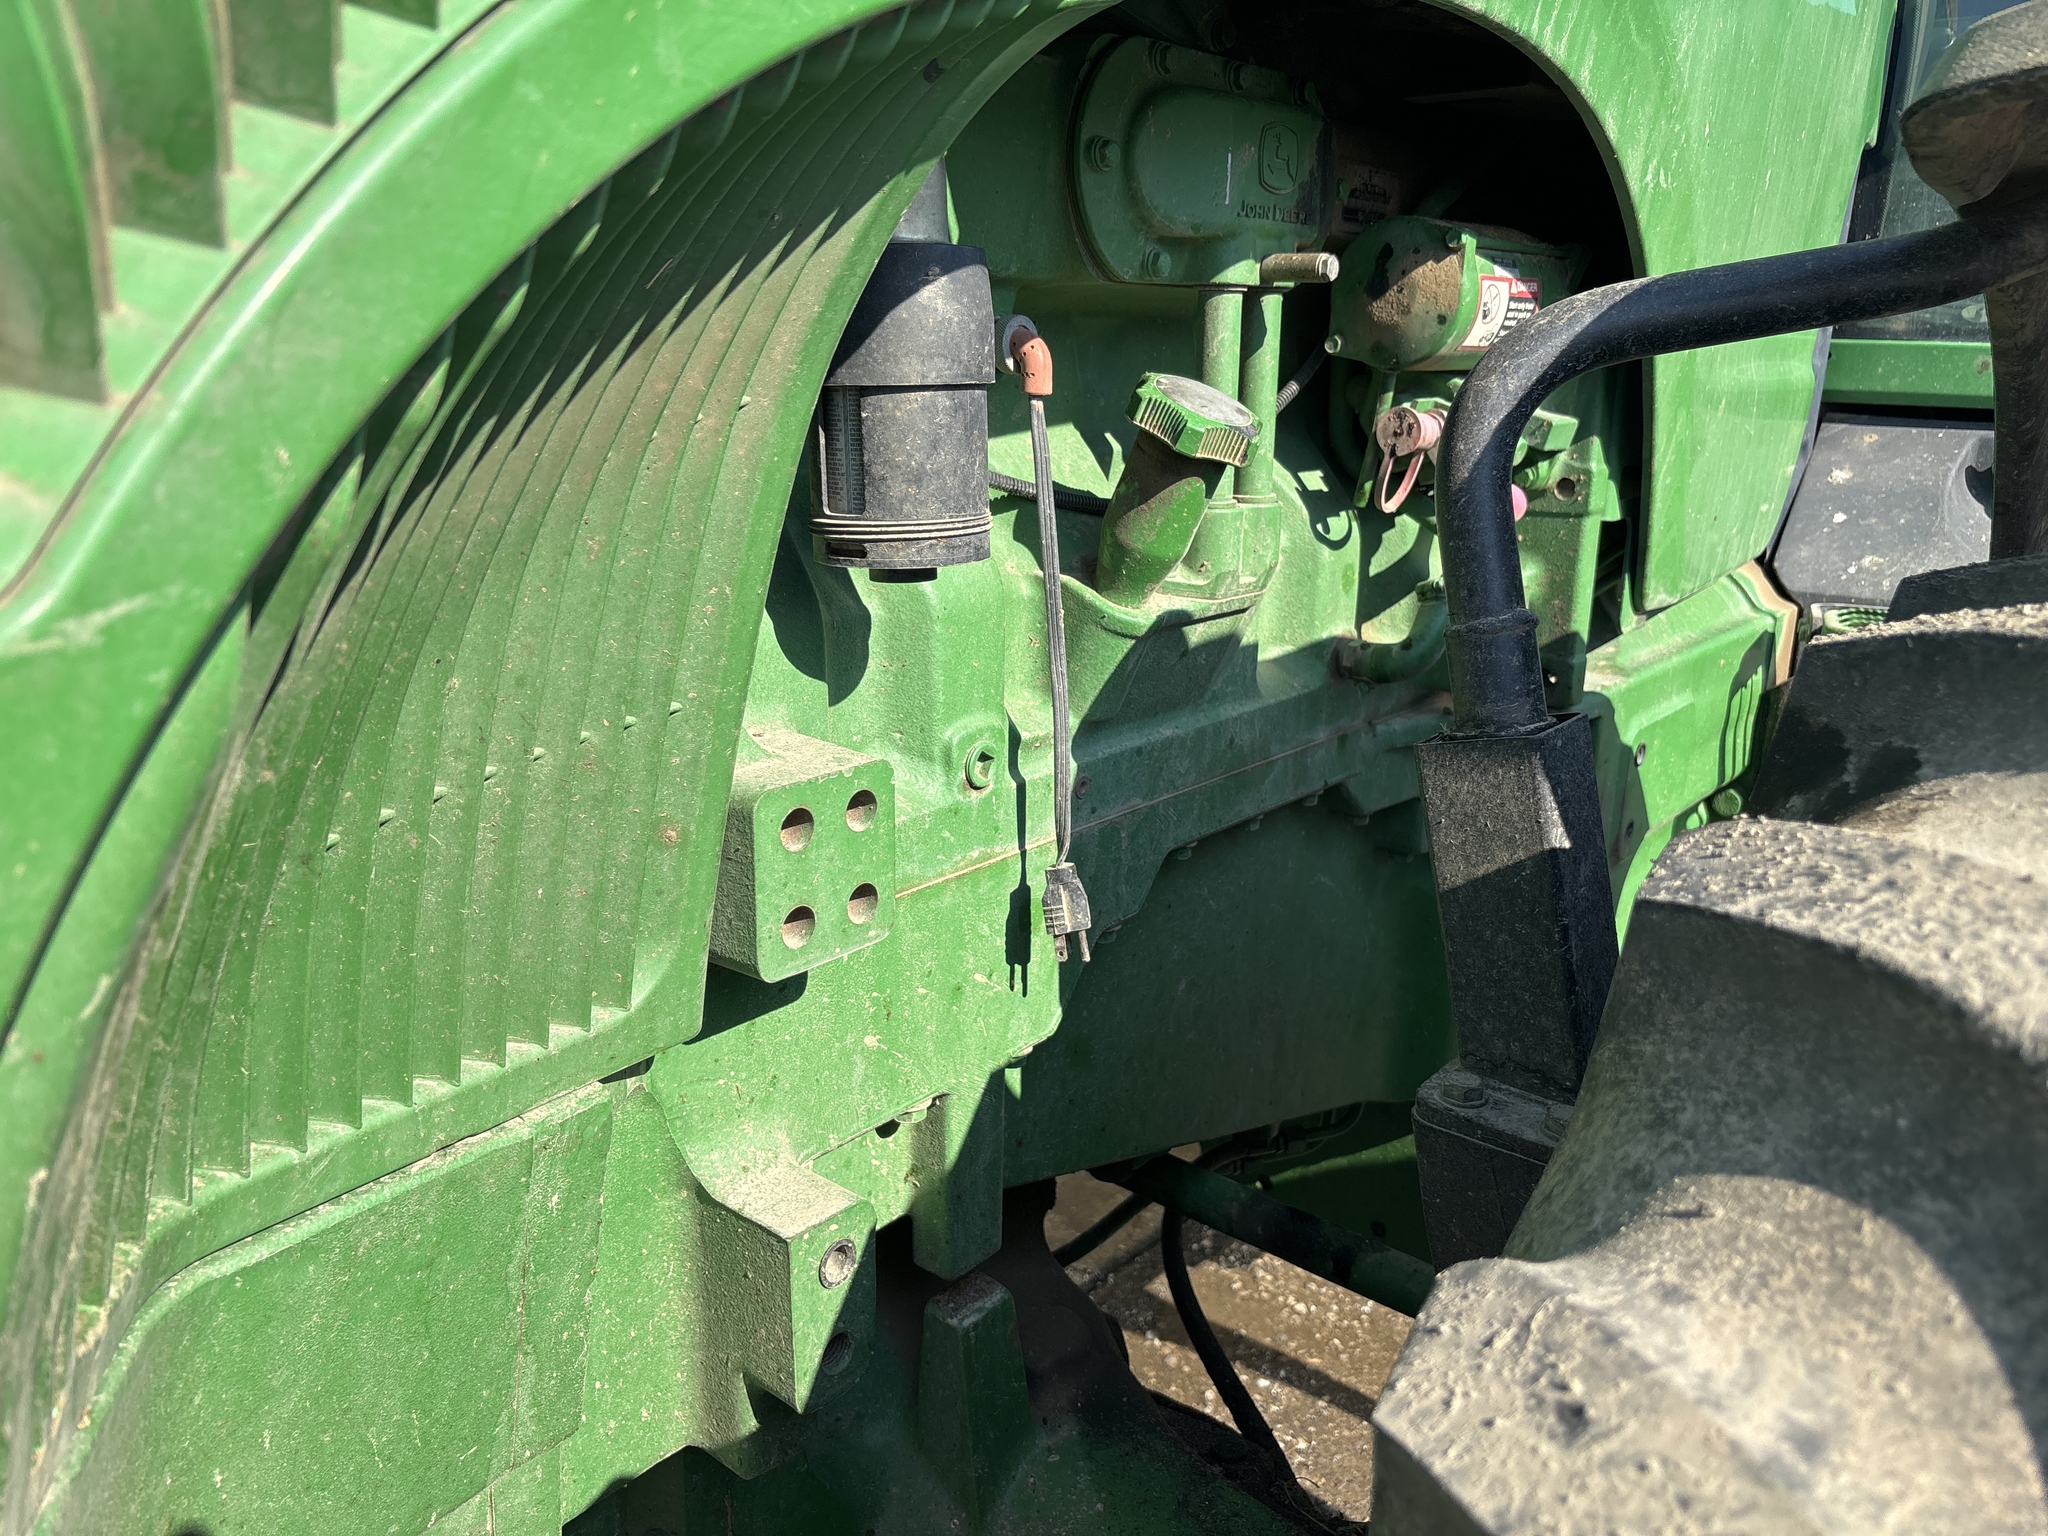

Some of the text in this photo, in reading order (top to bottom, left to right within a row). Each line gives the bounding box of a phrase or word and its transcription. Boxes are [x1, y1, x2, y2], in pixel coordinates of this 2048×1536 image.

[1236, 199, 1312, 226] JOHN DEERE
[1517, 281, 1538, 292] DANGER
